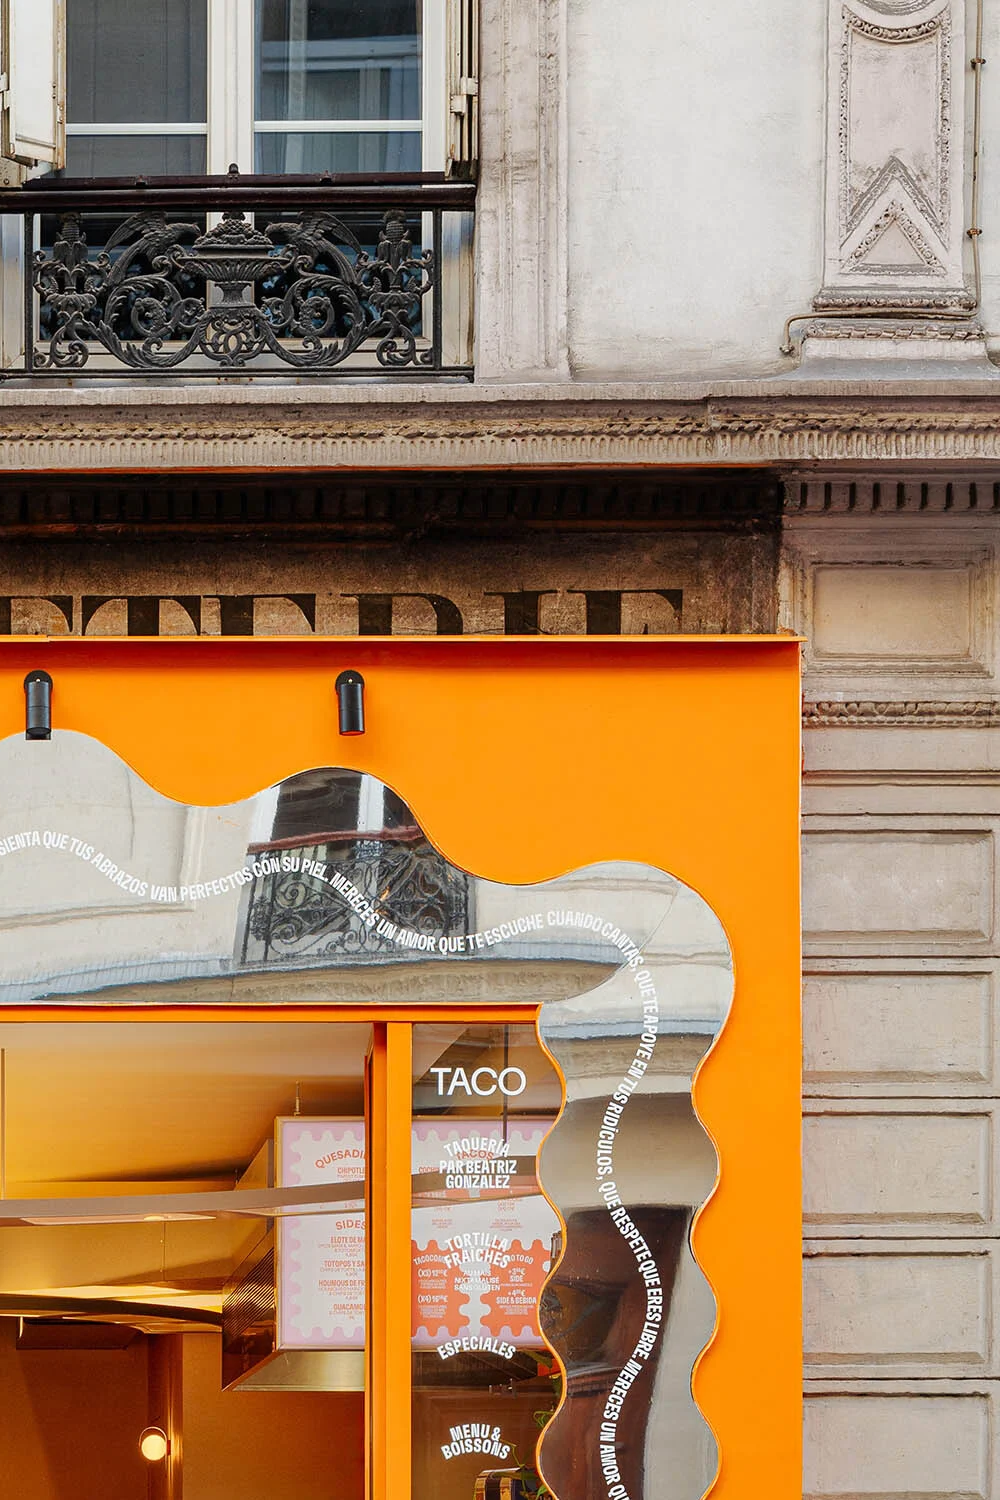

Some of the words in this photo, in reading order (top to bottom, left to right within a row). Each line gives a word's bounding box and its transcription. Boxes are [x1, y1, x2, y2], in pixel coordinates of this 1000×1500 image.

[43, 831, 69, 850] QUE
[69, 837, 95, 861] TUS
[90, 852, 149, 897] ABRAZOS
[252, 857, 281, 878] CON
[282, 857, 300, 872] SU
[300, 858, 329, 882] PIEL.
[150, 884, 177, 902] VAN
[180, 866, 253, 901] PERFECTOS
[329, 871, 380, 928] MERECES
[376, 918, 398, 940] UN
[484, 913, 545, 945] ESCUCHE
[547, 910, 603, 932] CUANDO
[395, 930, 436, 952] AMOR
[438, 936, 465, 956] QUE
[466, 932, 485, 950] TE
[601, 922, 644, 973] CANTAS,
[633, 970, 656, 997] QUE
[643, 997, 659, 1013] TE
[636, 1014, 659, 1061] APOYE
[627, 1058, 648, 1080] EN
[430, 1066, 527, 1096] TACO
[612, 1077, 638, 1105] TUS
[315, 1149, 365, 1168] QUESADI
[443, 1137, 510, 1157] TAQUERÍA
[439, 1160, 465, 1174] PAR
[466, 1160, 517, 1174] BEATRIZ
[446, 1175, 510, 1189] GONZALEZ
[598, 1181, 622, 1210] QUE
[444, 1232, 509, 1252] TORTILLA
[610, 1206, 652, 1263] RESPETE
[638, 1259, 661, 1288] QUE
[646, 1287, 663, 1322] ERES
[436, 1336, 516, 1360] ESPECIALES
[632, 1321, 660, 1361] LIBRE.
[603, 1359, 643, 1421] MERECES
[449, 1423, 491, 1441] MENU
[491, 1427, 502, 1441] &
[600, 1421, 617, 1442] UN
[441, 1439, 511, 1460] BOISSONS
[600, 1444, 621, 1486] AMOR
